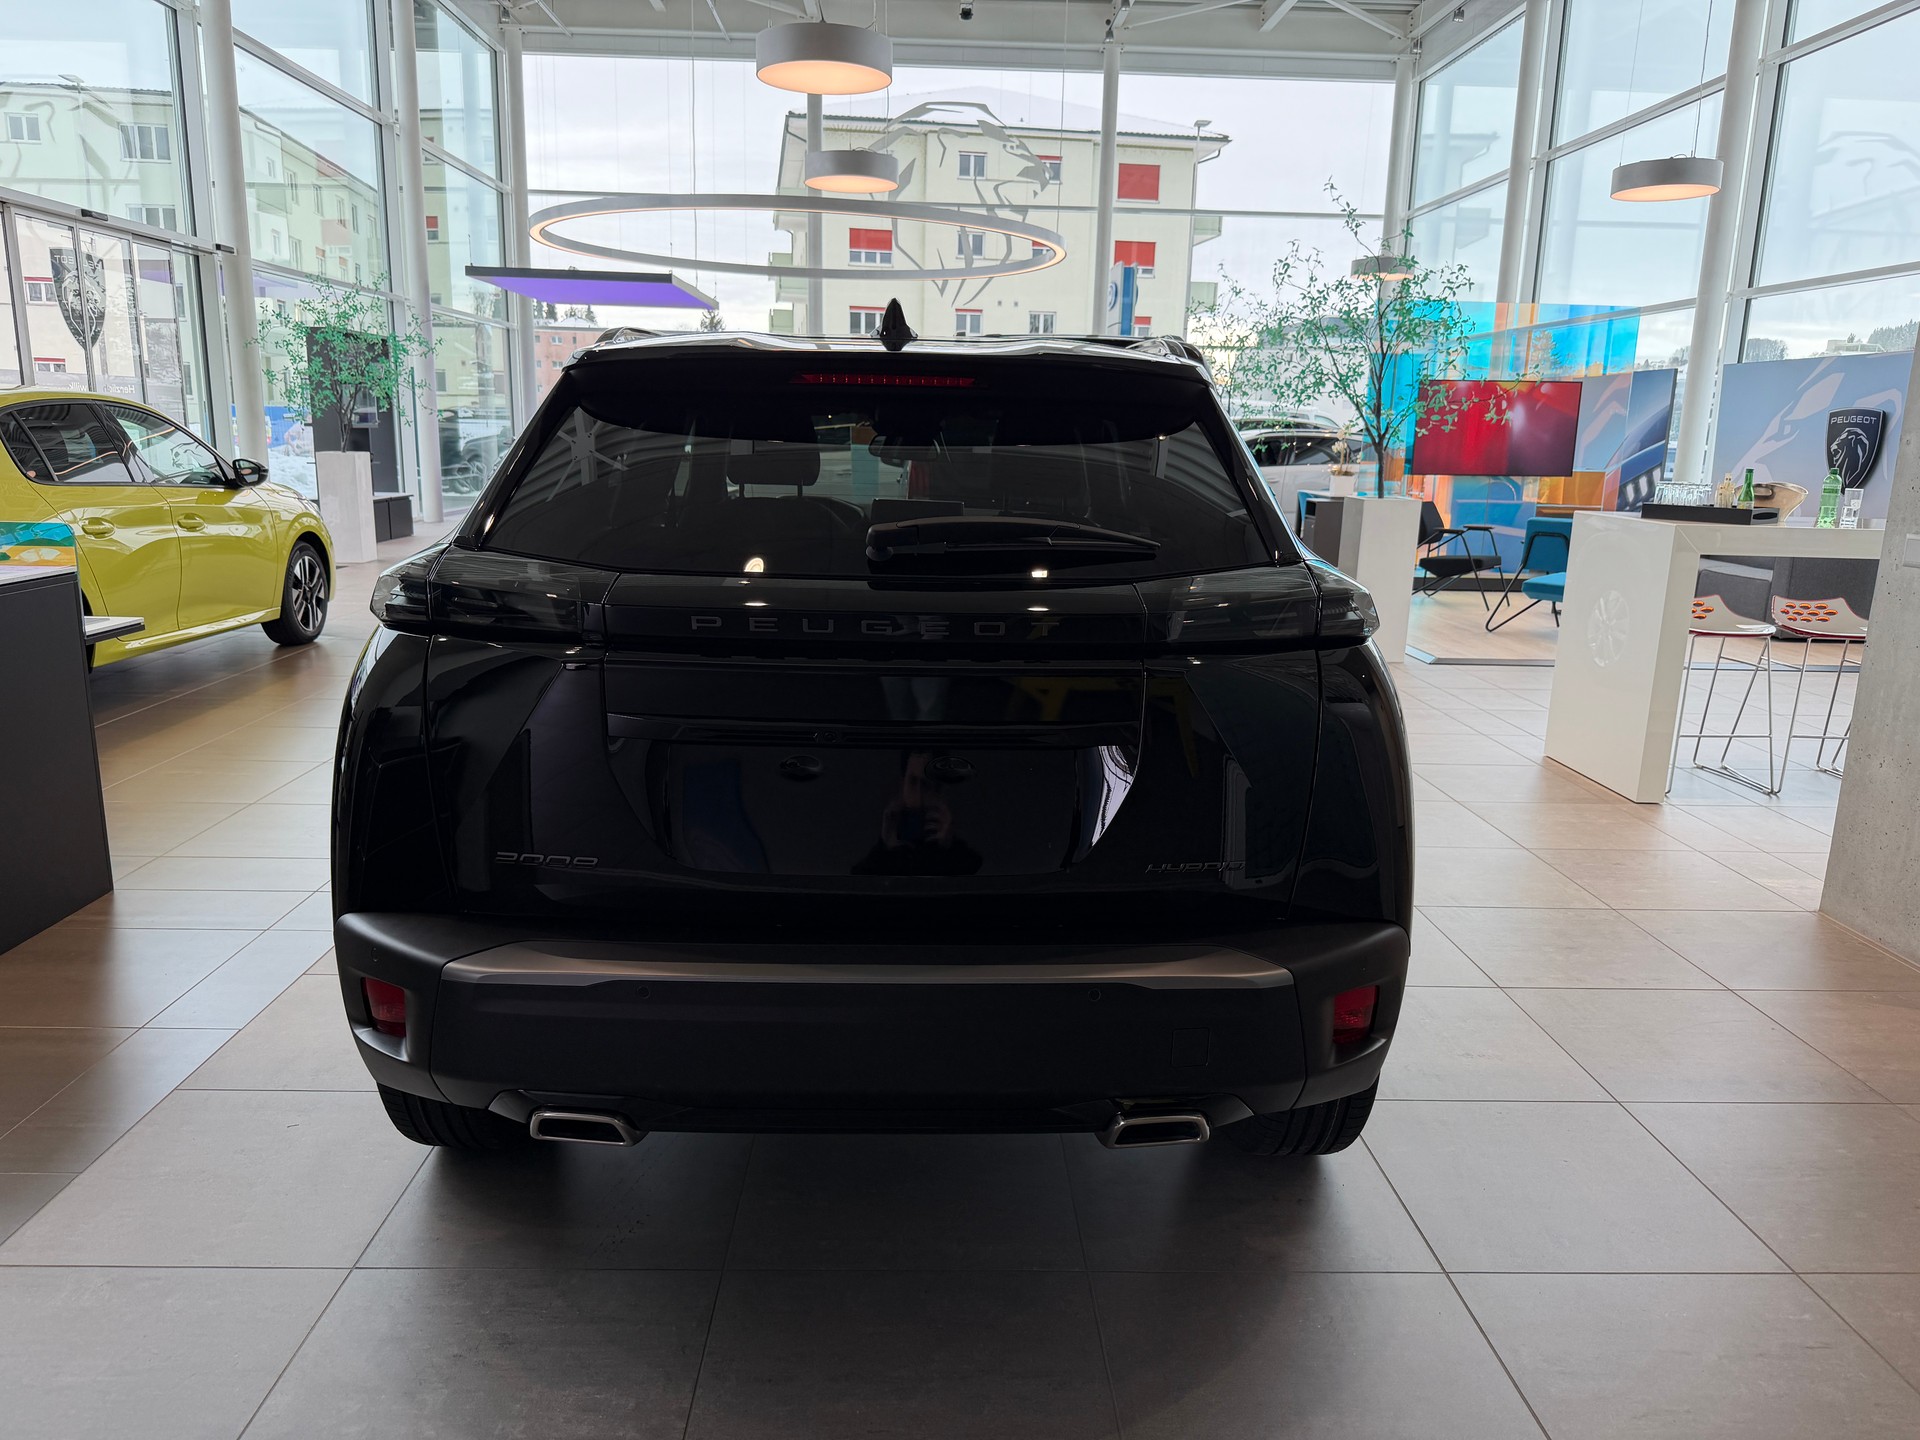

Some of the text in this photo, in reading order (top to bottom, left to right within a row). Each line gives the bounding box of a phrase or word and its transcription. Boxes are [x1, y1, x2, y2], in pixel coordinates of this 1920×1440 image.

[1830, 415, 1877, 425] PEUGEOT
[690, 614, 1060, 638] PEUGEOT
[495, 851, 600, 869] 2008
